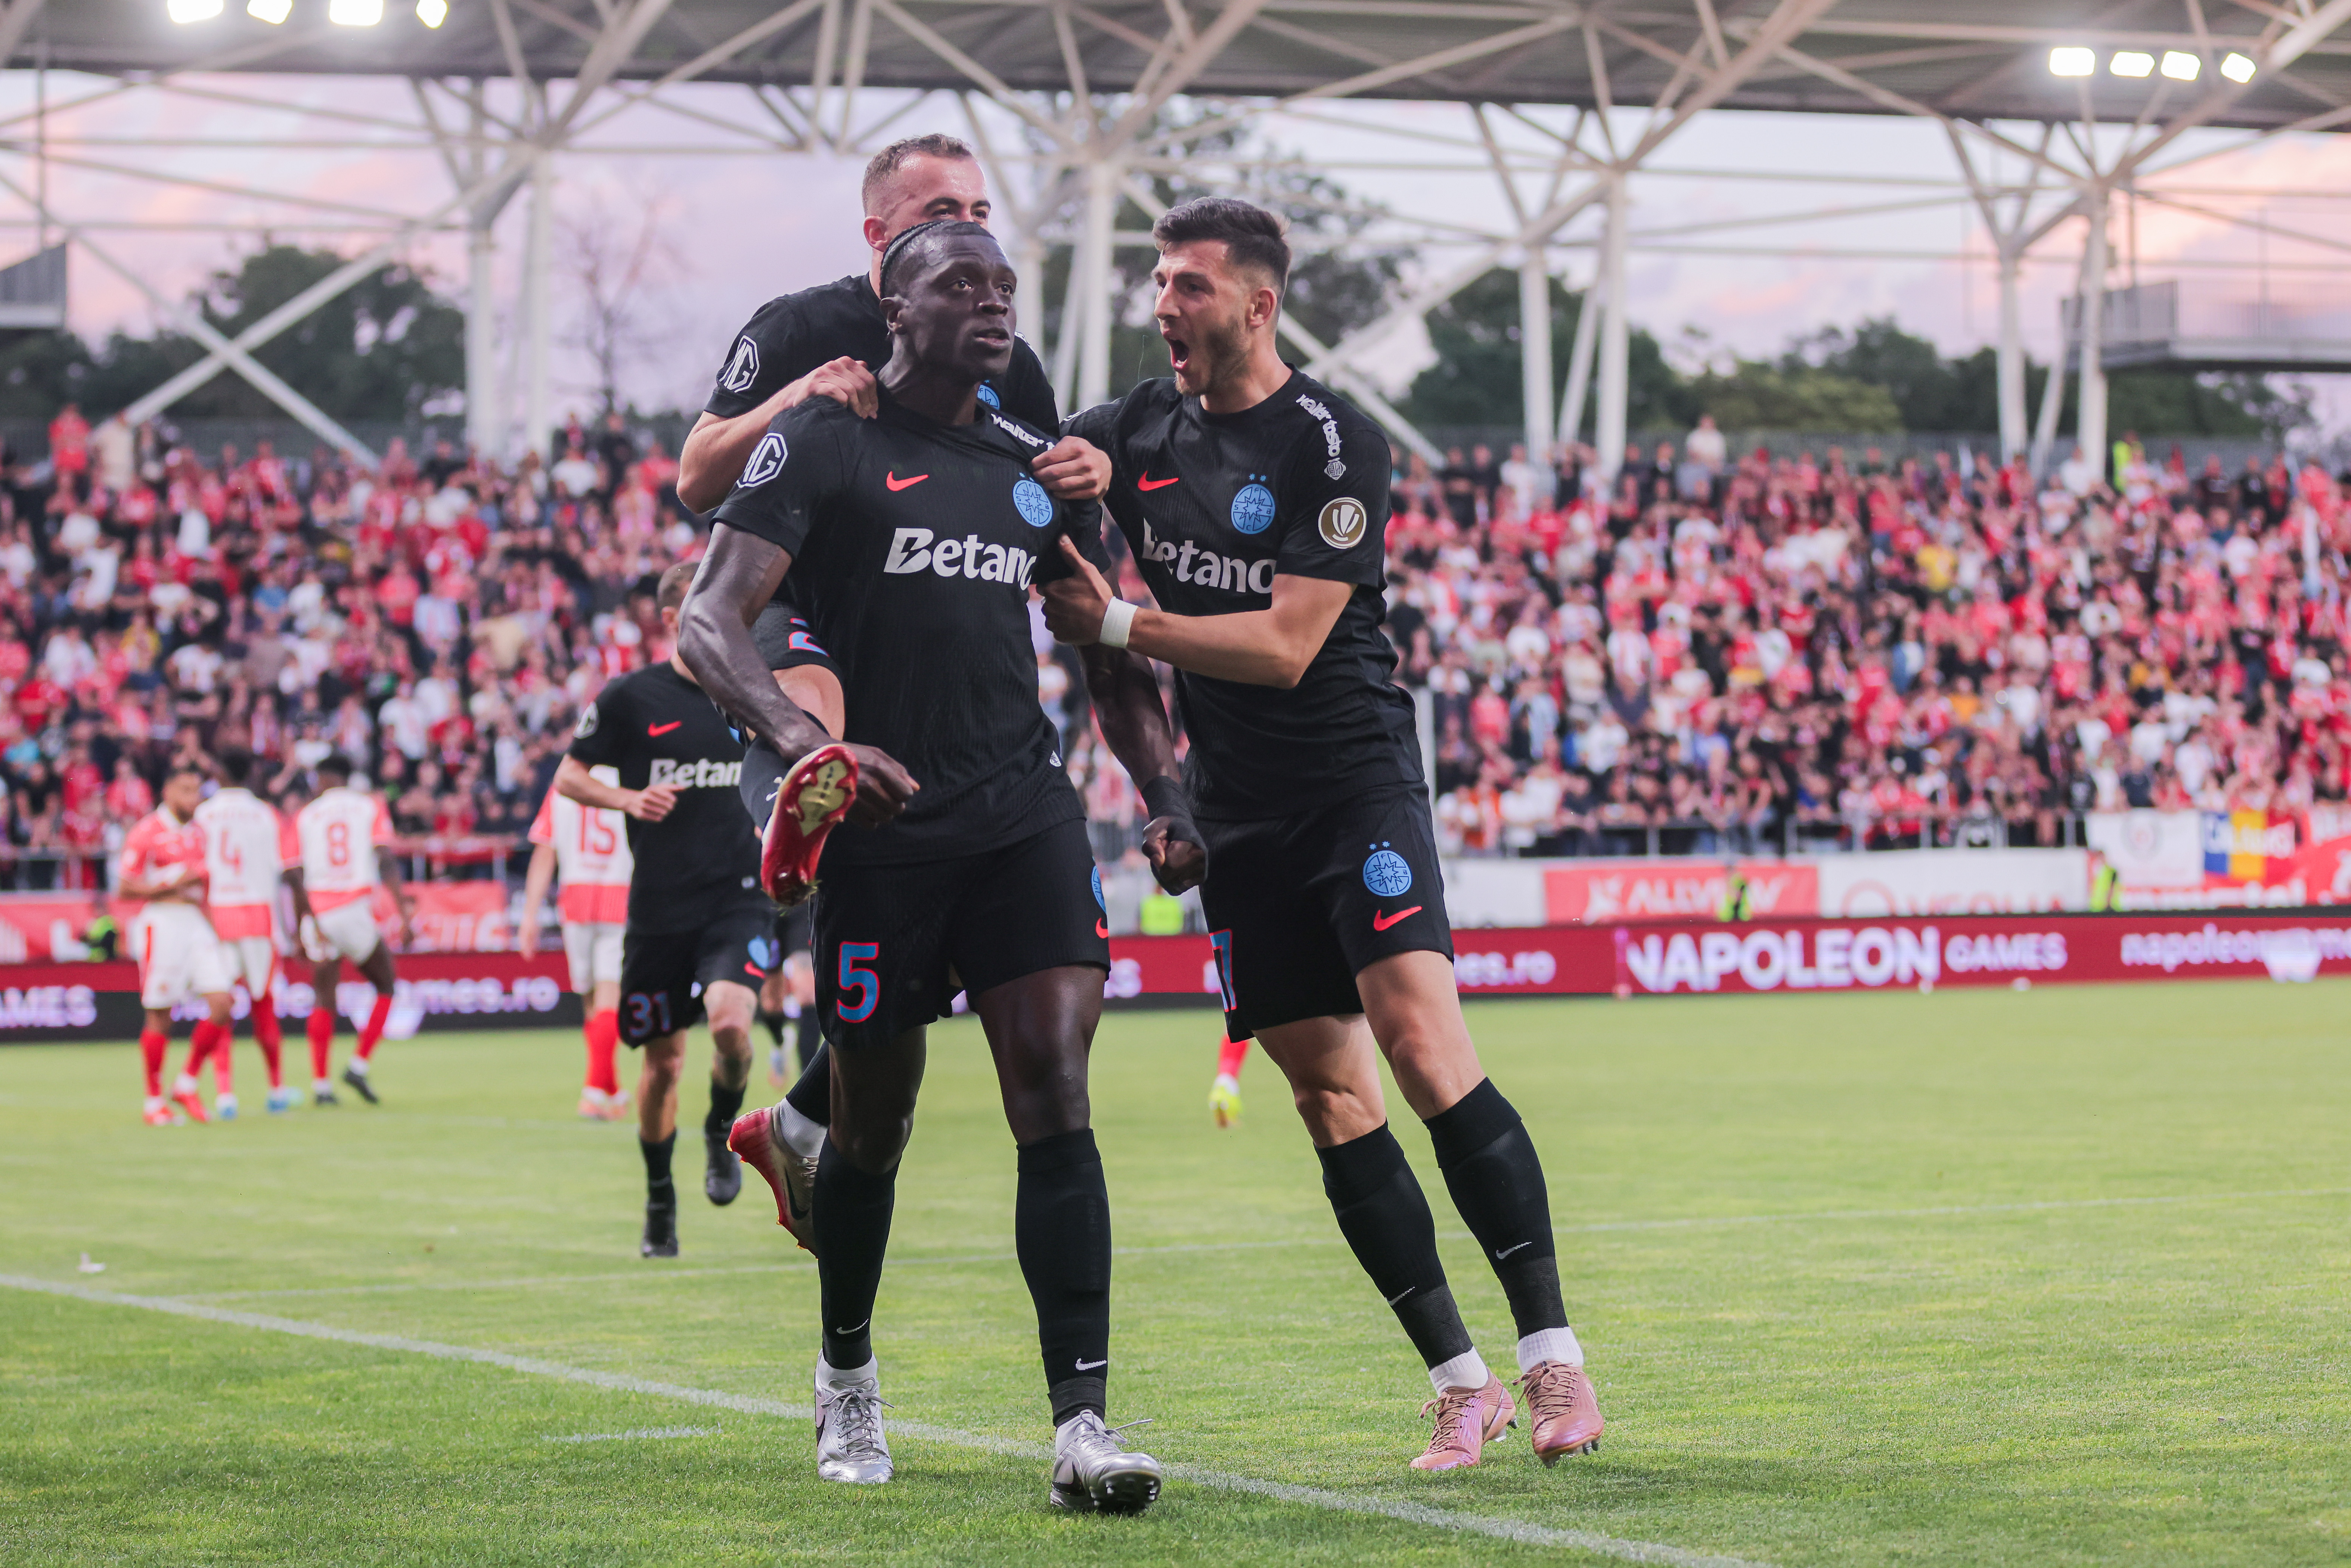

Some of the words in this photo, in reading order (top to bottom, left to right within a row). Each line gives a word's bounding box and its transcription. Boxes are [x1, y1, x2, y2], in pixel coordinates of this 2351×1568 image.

[991, 413, 1045, 447] walter
[1322, 419, 1342, 457] tosto
[649, 758, 742, 788] Betan
[219, 828, 242, 875] 4
[327, 822, 349, 866] 8
[577, 805, 617, 855] 15
[837, 941, 880, 1023] 5
[1626, 926, 1940, 991] NAPOLEON
[1945, 933, 2068, 972] GAMES
[627, 991, 671, 1038] 31
